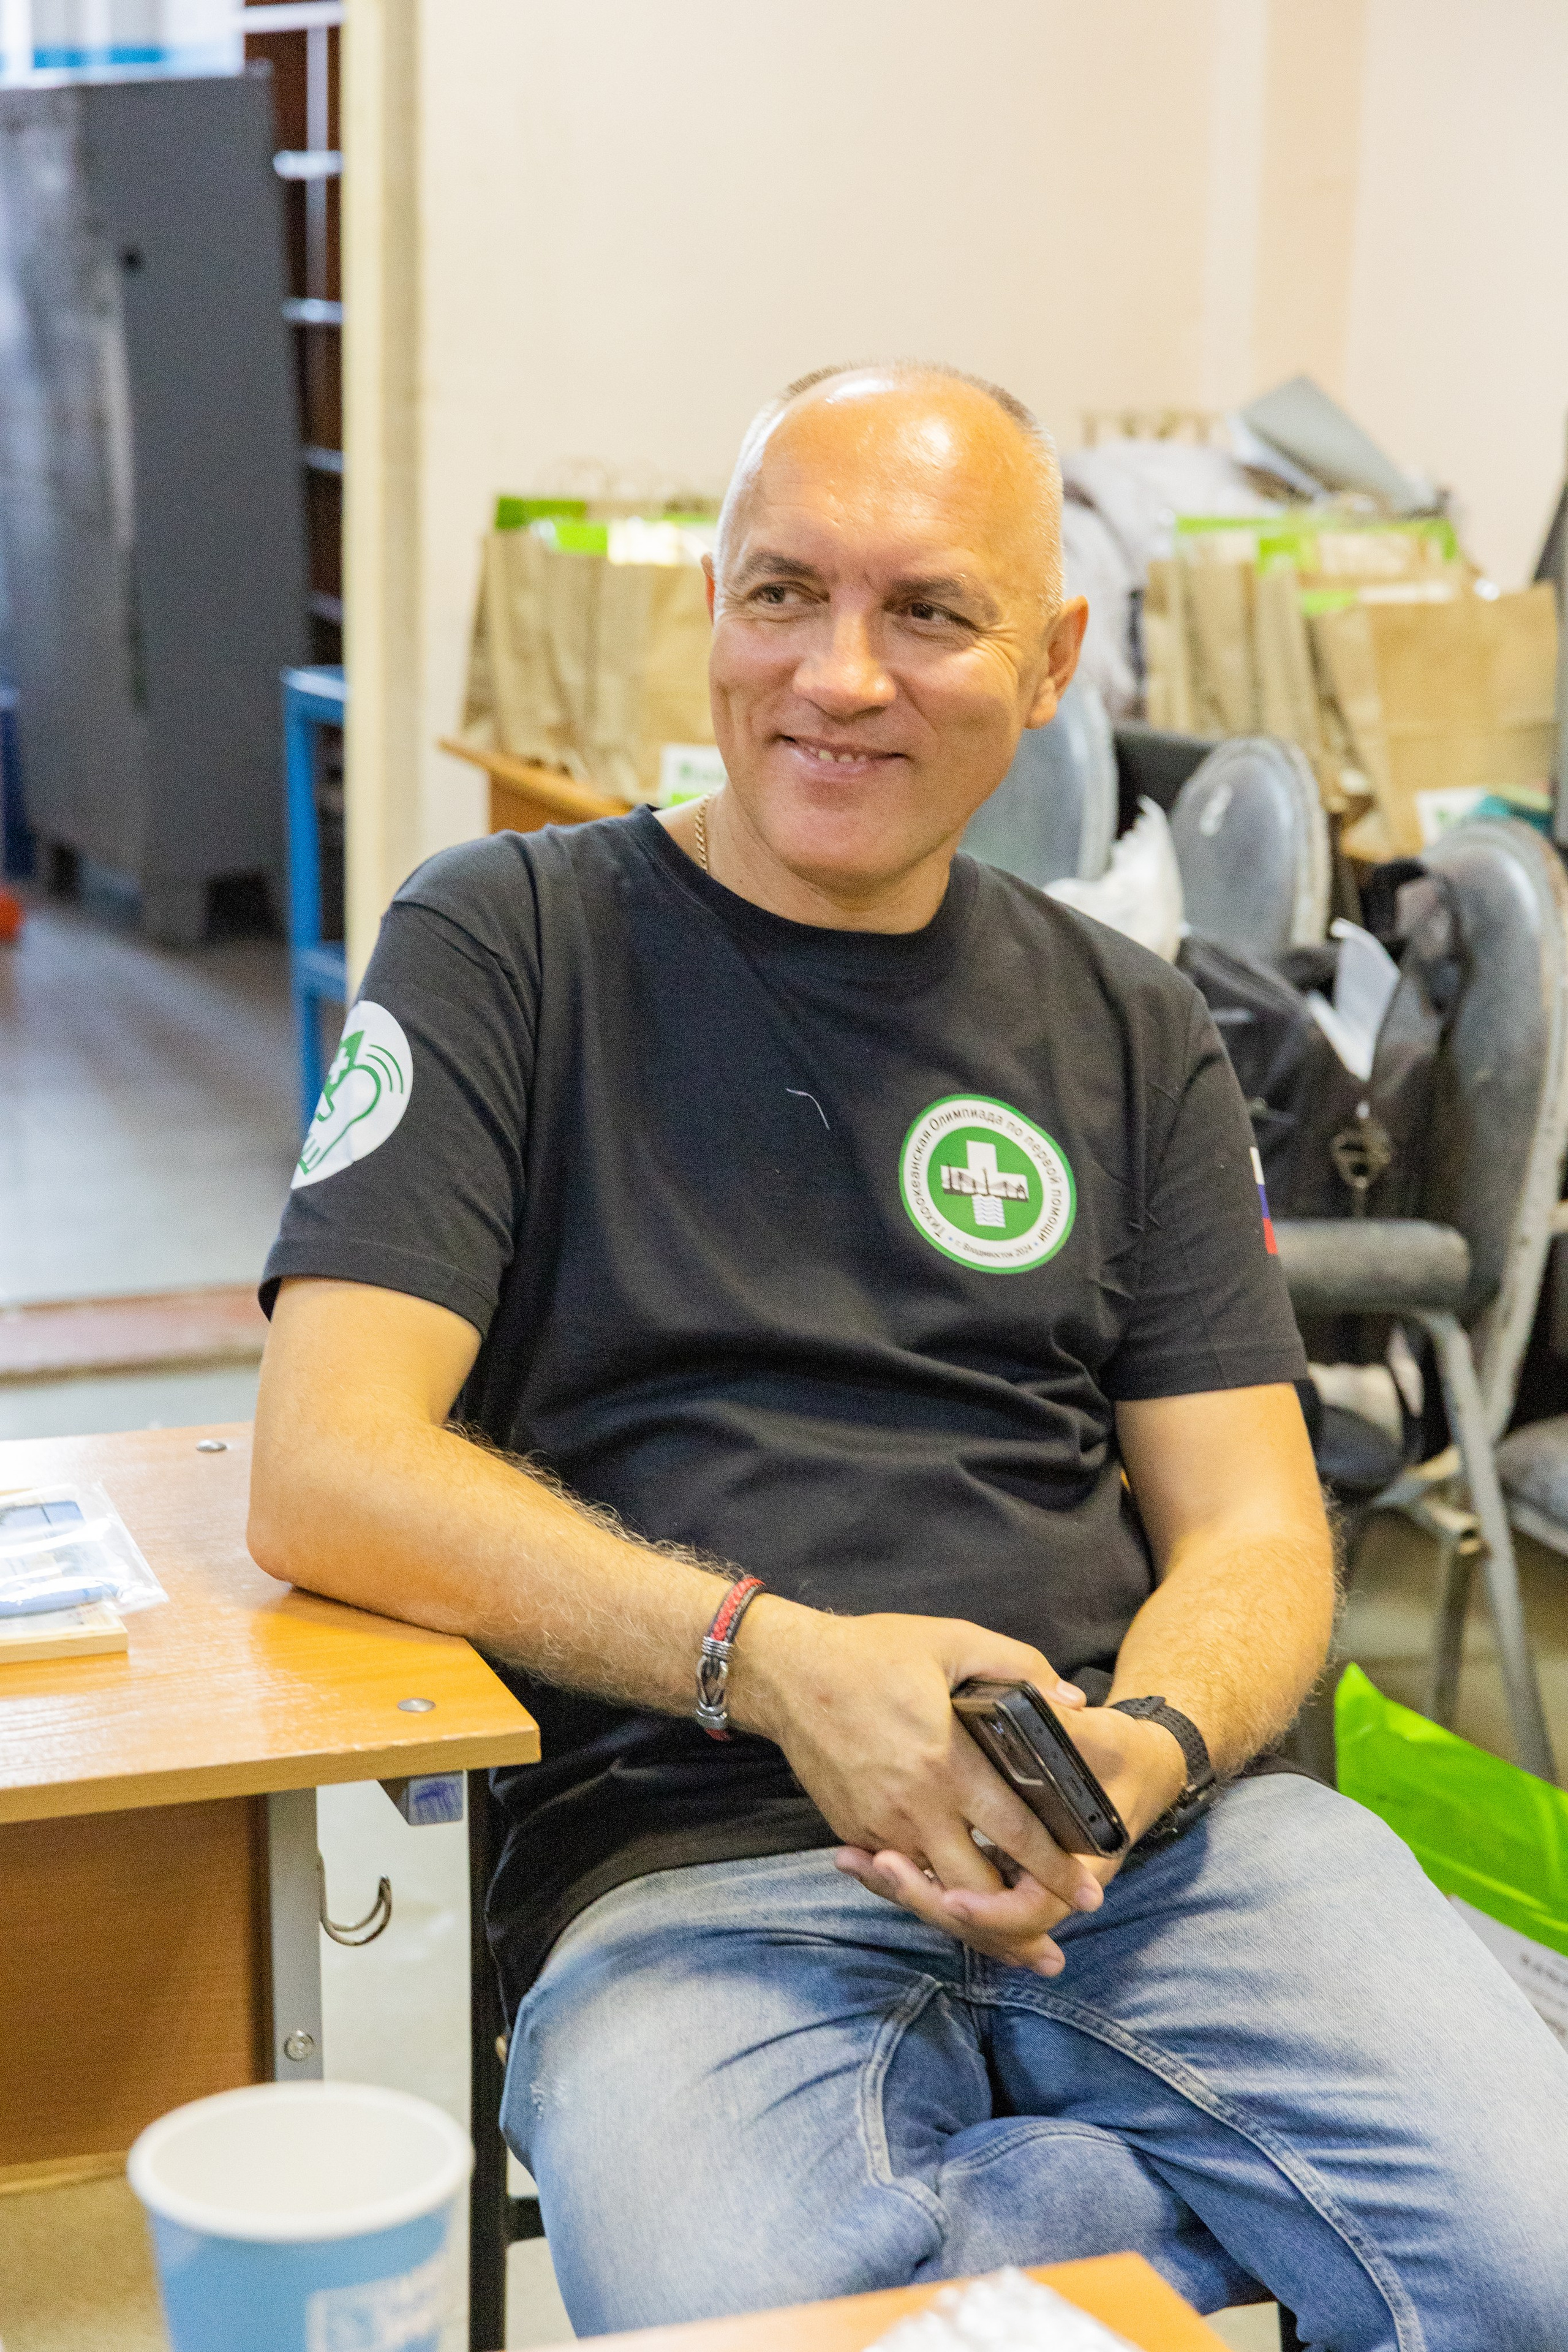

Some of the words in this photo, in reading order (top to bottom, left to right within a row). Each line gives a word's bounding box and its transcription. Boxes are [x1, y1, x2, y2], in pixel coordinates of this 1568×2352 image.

[929, 1108, 1003, 1131] Олимпиада
[1006, 1121, 1023, 1138] по
[910, 1130, 945, 1238] Тихоокеанская
[1023, 1136, 1062, 1185] первой
[1037, 1189, 1061, 1243] помощи
